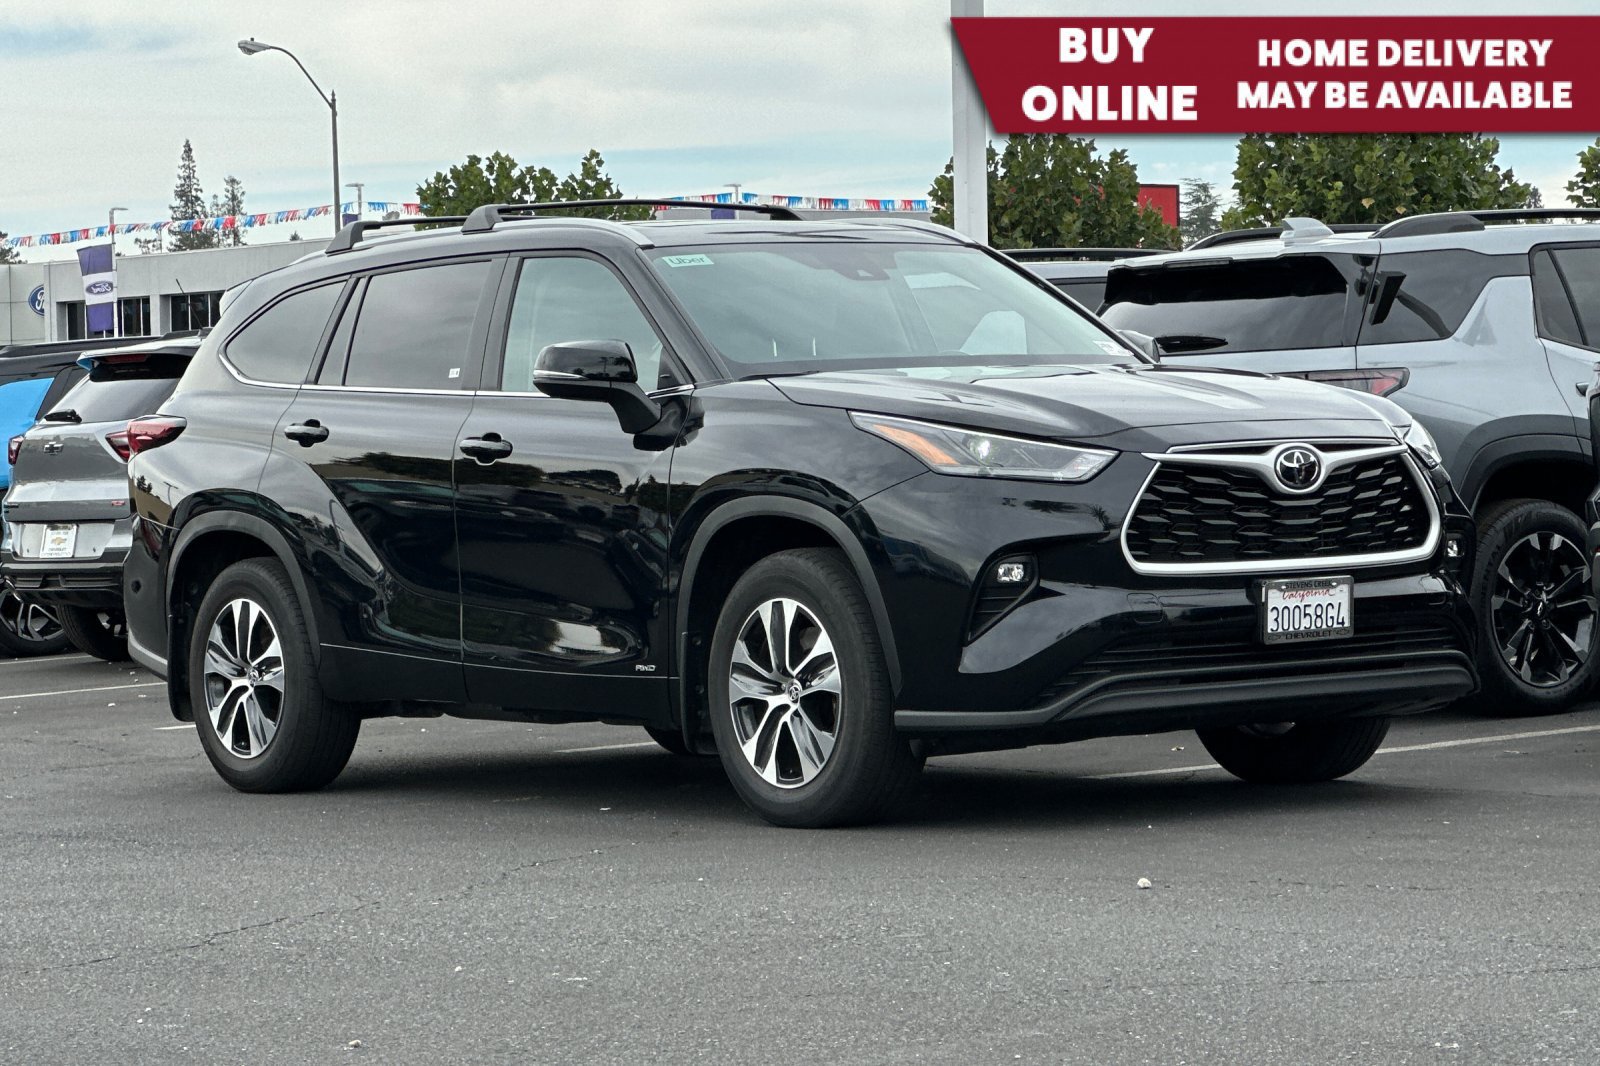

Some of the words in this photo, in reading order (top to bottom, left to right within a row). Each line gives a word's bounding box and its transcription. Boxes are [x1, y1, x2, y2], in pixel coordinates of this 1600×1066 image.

[668, 257, 705, 265] Uber
[1285, 581, 1313, 589] STEVENS
[1282, 588, 1336, 603] California
[1270, 602, 1346, 632] 30058G4
[1285, 630, 1332, 640] CHEVROLET
